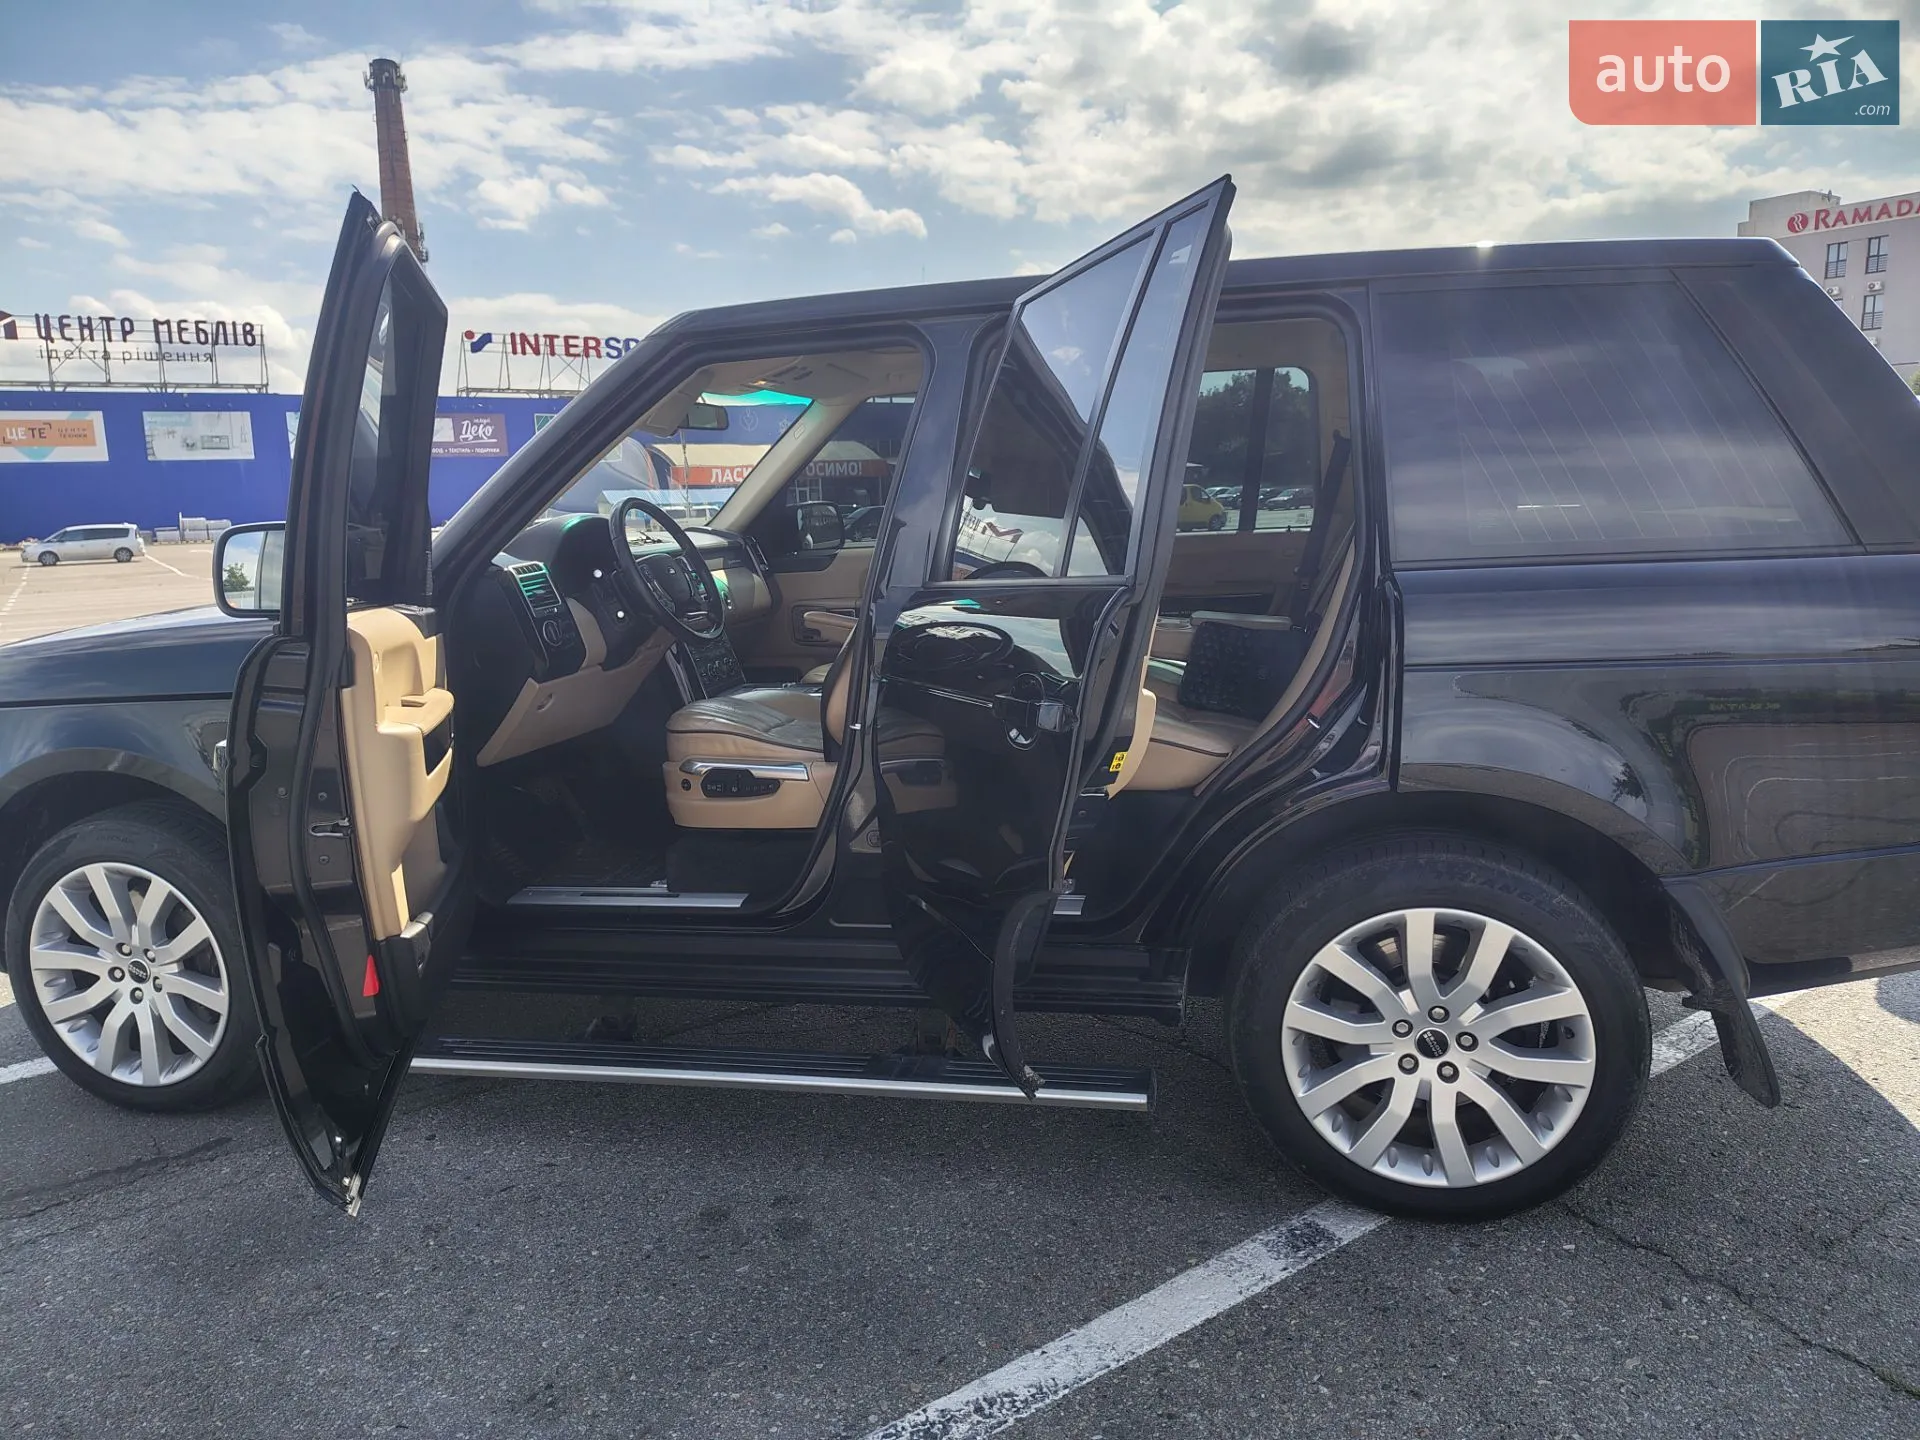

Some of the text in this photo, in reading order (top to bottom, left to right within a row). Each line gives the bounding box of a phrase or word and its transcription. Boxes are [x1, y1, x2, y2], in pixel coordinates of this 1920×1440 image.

[34, 313, 257, 347] ЦЕНТР МЕБЛІВ
[805, 461, 863, 477] ОСИМО!
